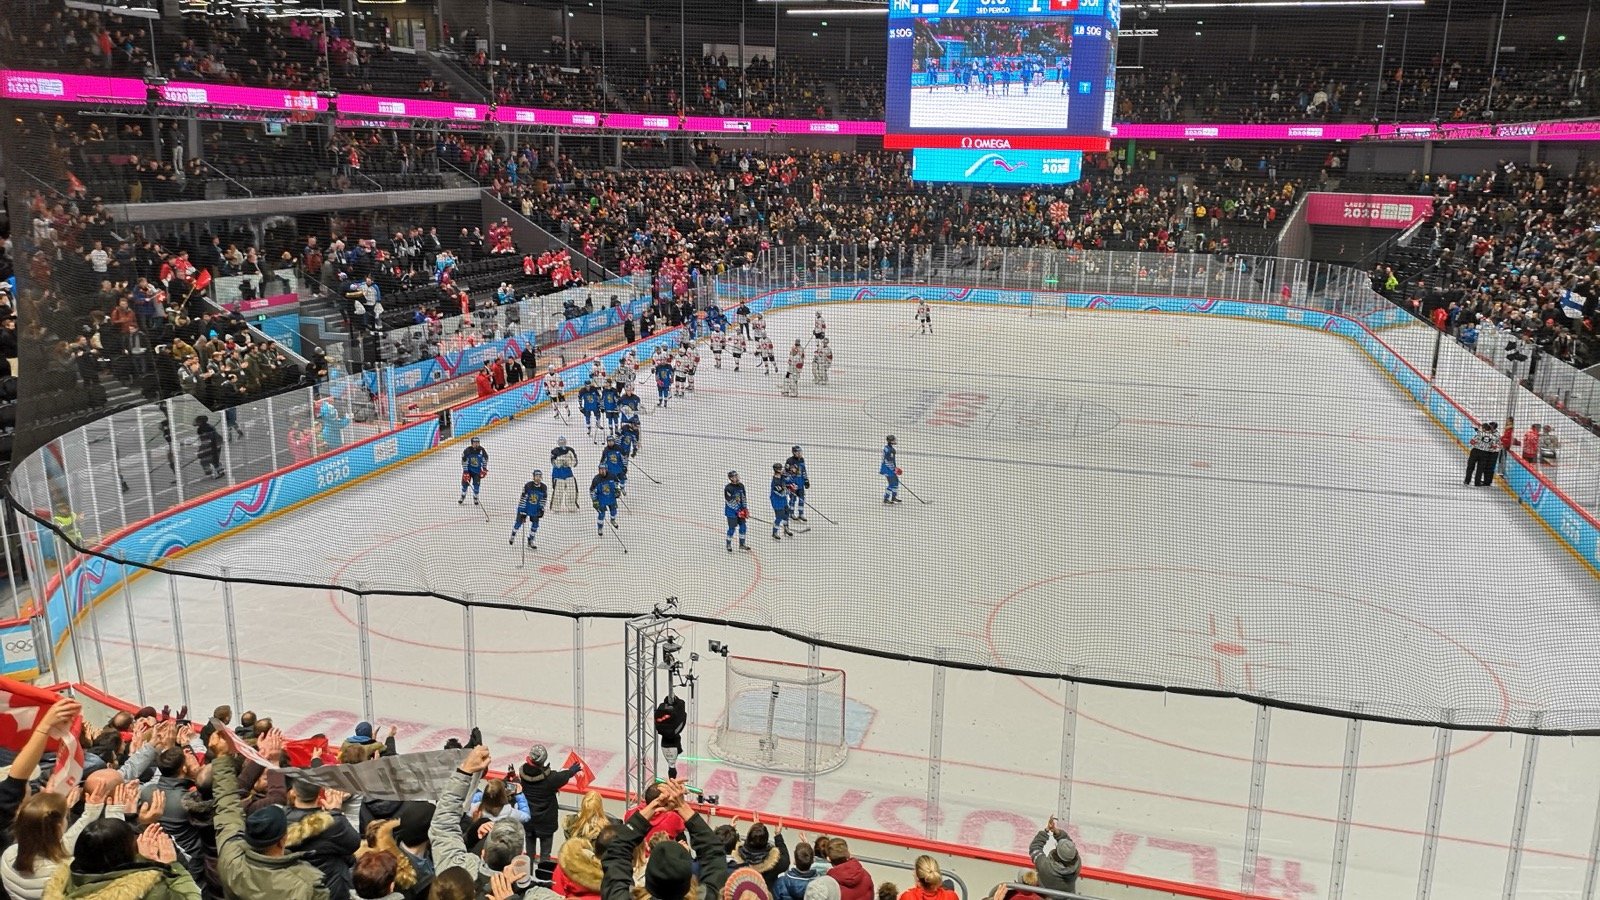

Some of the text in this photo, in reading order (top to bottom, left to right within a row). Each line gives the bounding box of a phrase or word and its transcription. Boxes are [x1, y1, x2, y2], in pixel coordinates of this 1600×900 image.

[896, 28, 912, 38] SOG
[1086, 26, 1101, 36] SOG
[974, 138, 1011, 149] OMEGA
[1344, 208, 1380, 218] 2020
[317, 465, 350, 489] 2020
